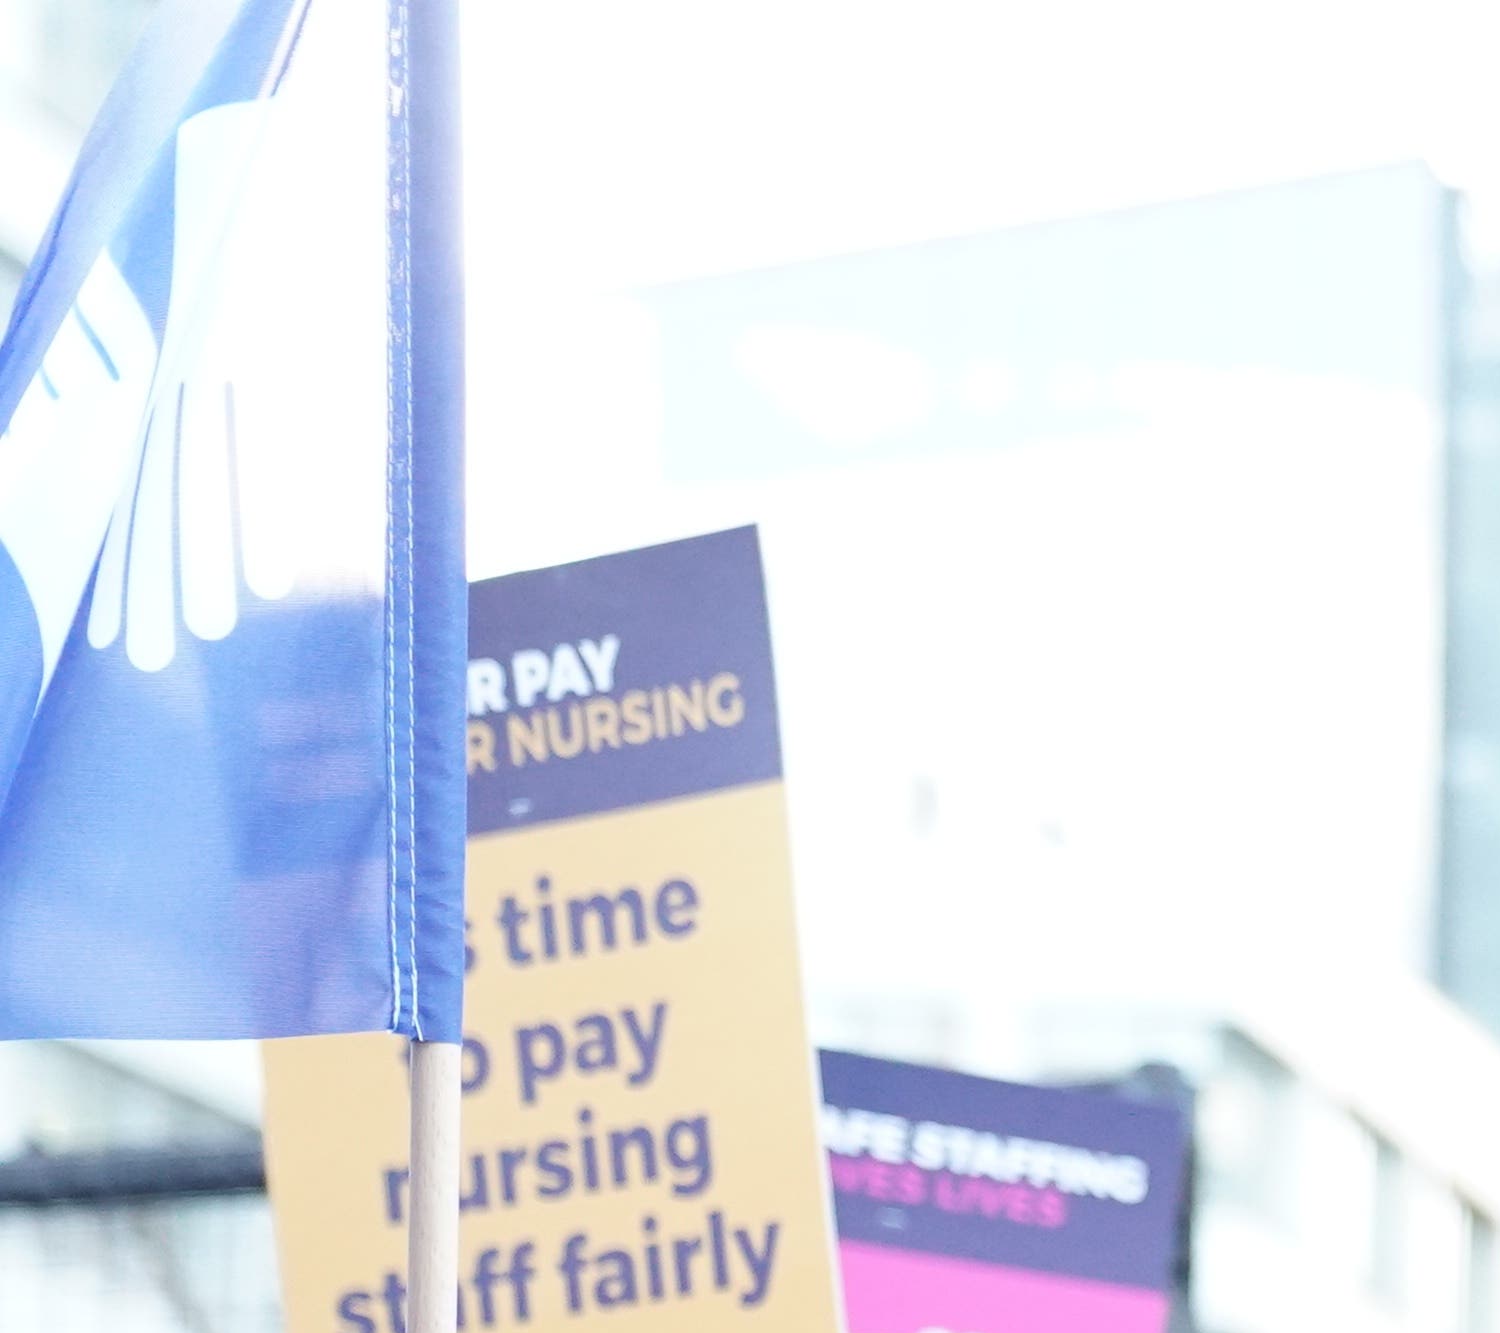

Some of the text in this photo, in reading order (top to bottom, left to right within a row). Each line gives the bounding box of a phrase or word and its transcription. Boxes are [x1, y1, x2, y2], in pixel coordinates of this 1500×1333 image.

[512, 634, 620, 707] PAY
[507, 672, 745, 767] NURSING
[495, 873, 700, 967] time
[514, 1000, 670, 1108] pay
[911, 1119, 1149, 1205] STAFFING
[557, 1208, 781, 1312] fairly
